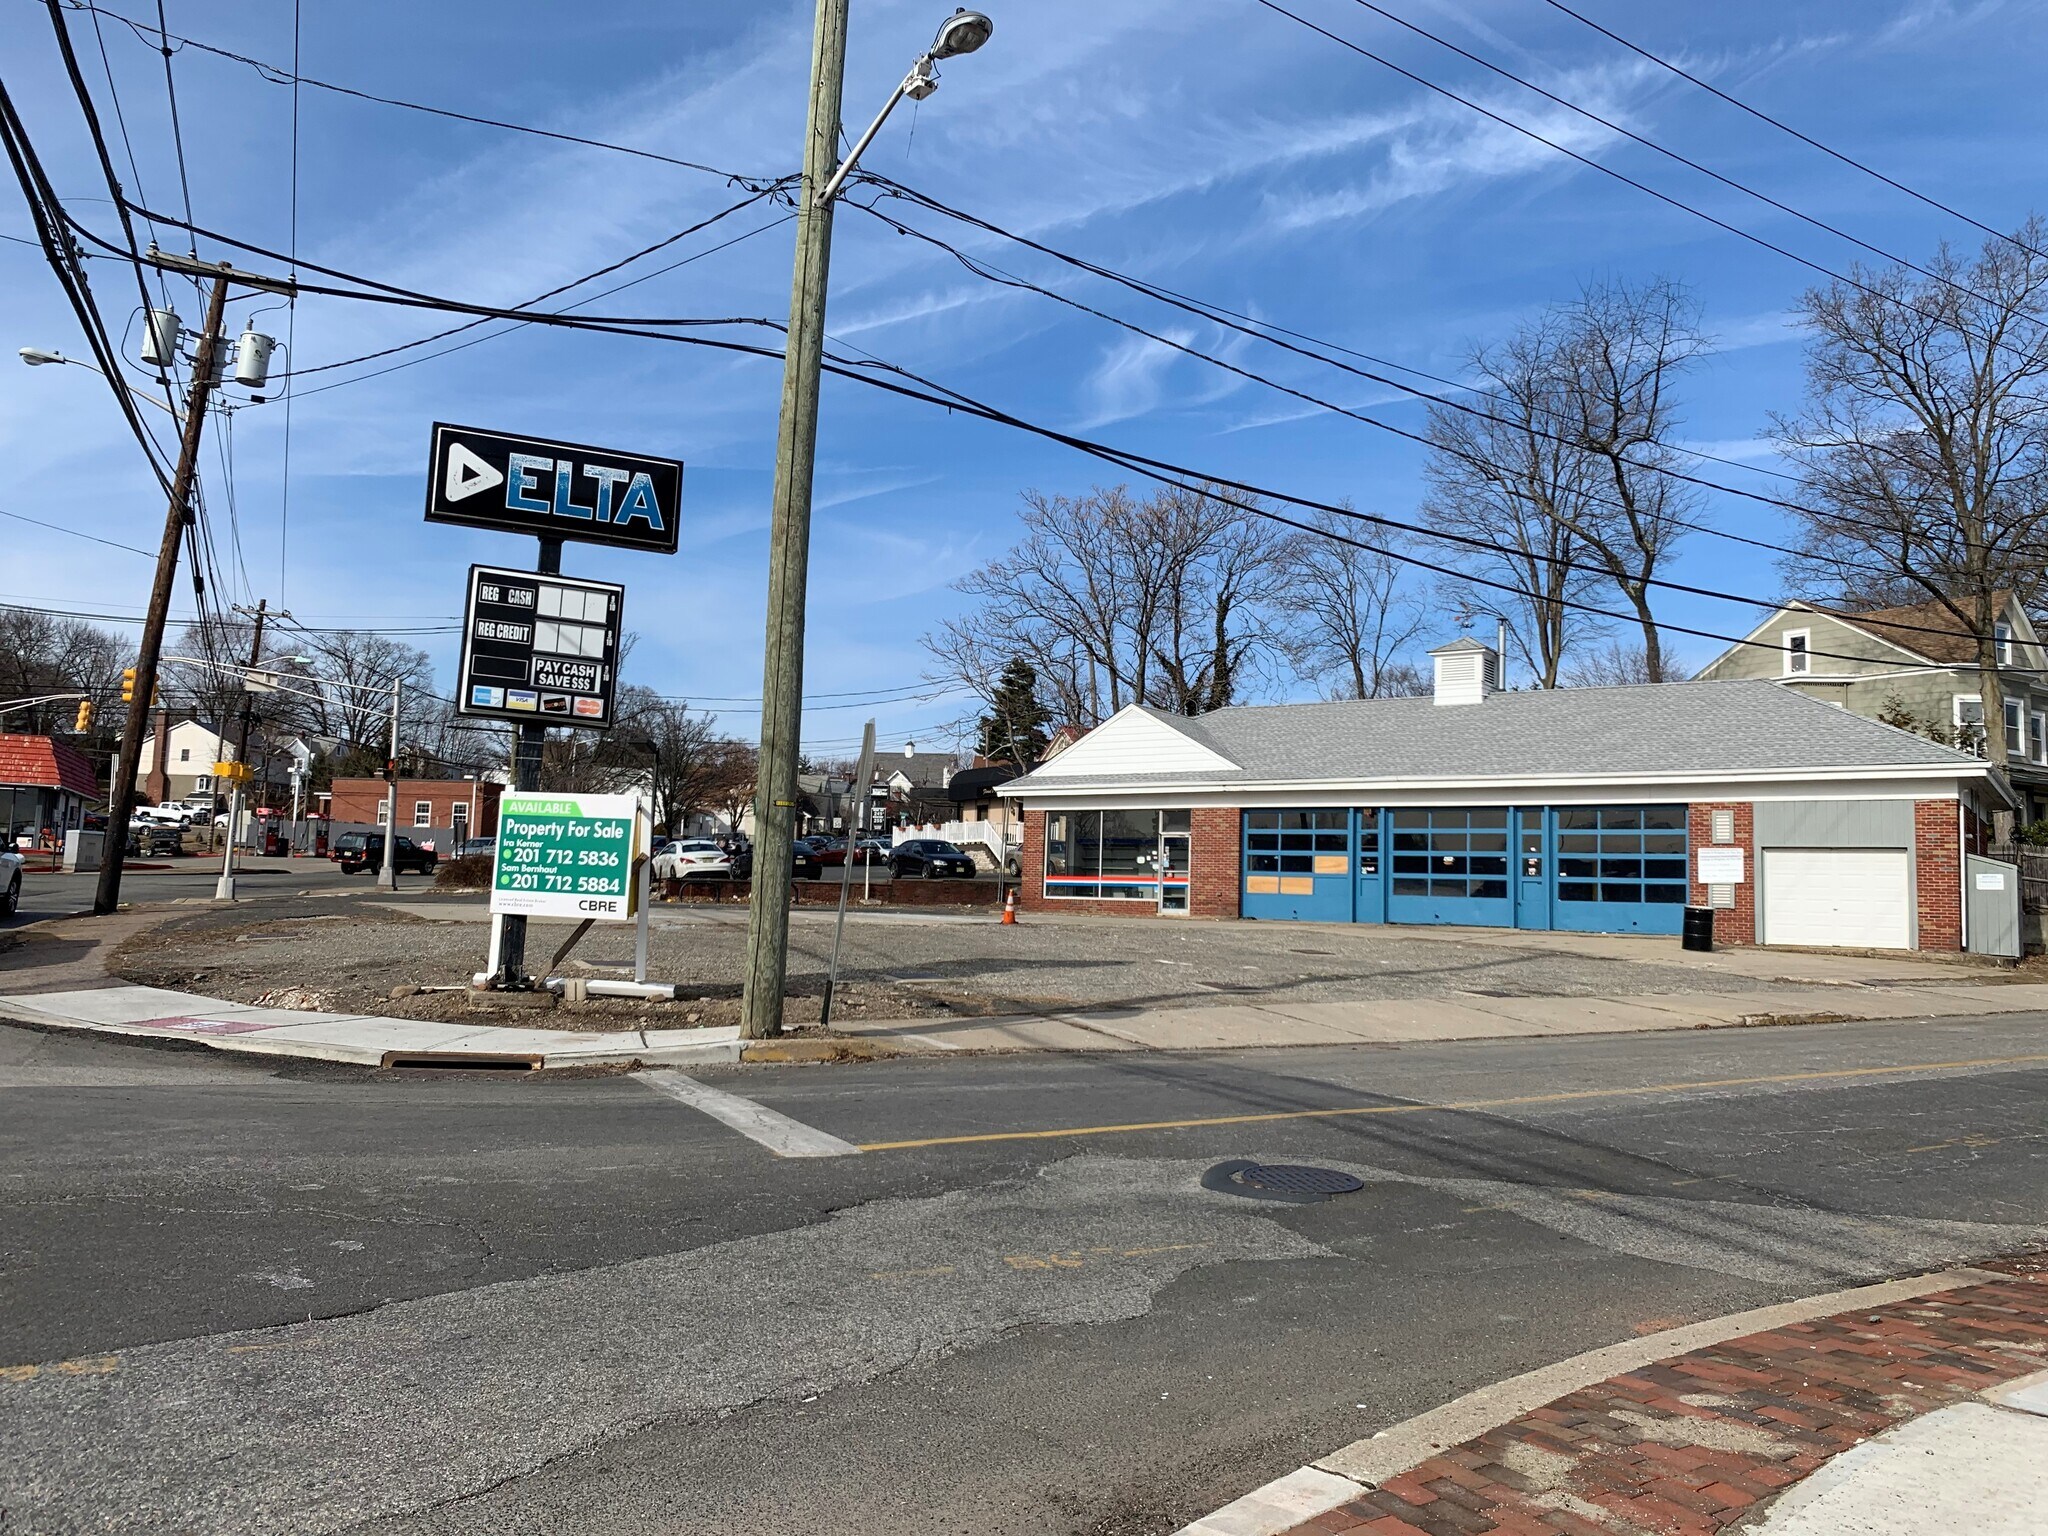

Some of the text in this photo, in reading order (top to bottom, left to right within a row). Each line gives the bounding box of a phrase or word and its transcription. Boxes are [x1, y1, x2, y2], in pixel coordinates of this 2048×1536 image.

[482, 585, 532, 605] REG CASH
[478, 622, 529, 641] REG CREDIT
[536, 660, 595, 677] PAY CASH
[538, 673, 571, 687] SAVE
[508, 801, 572, 814] AVAILABLE
[506, 819, 624, 841] Property For Sale
[503, 839, 515, 847] Ira
[513, 848, 619, 867] 201 712 5836
[501, 863, 519, 872] Sam
[511, 874, 620, 893] 201 712 5884
[578, 900, 617, 912] CBRE
